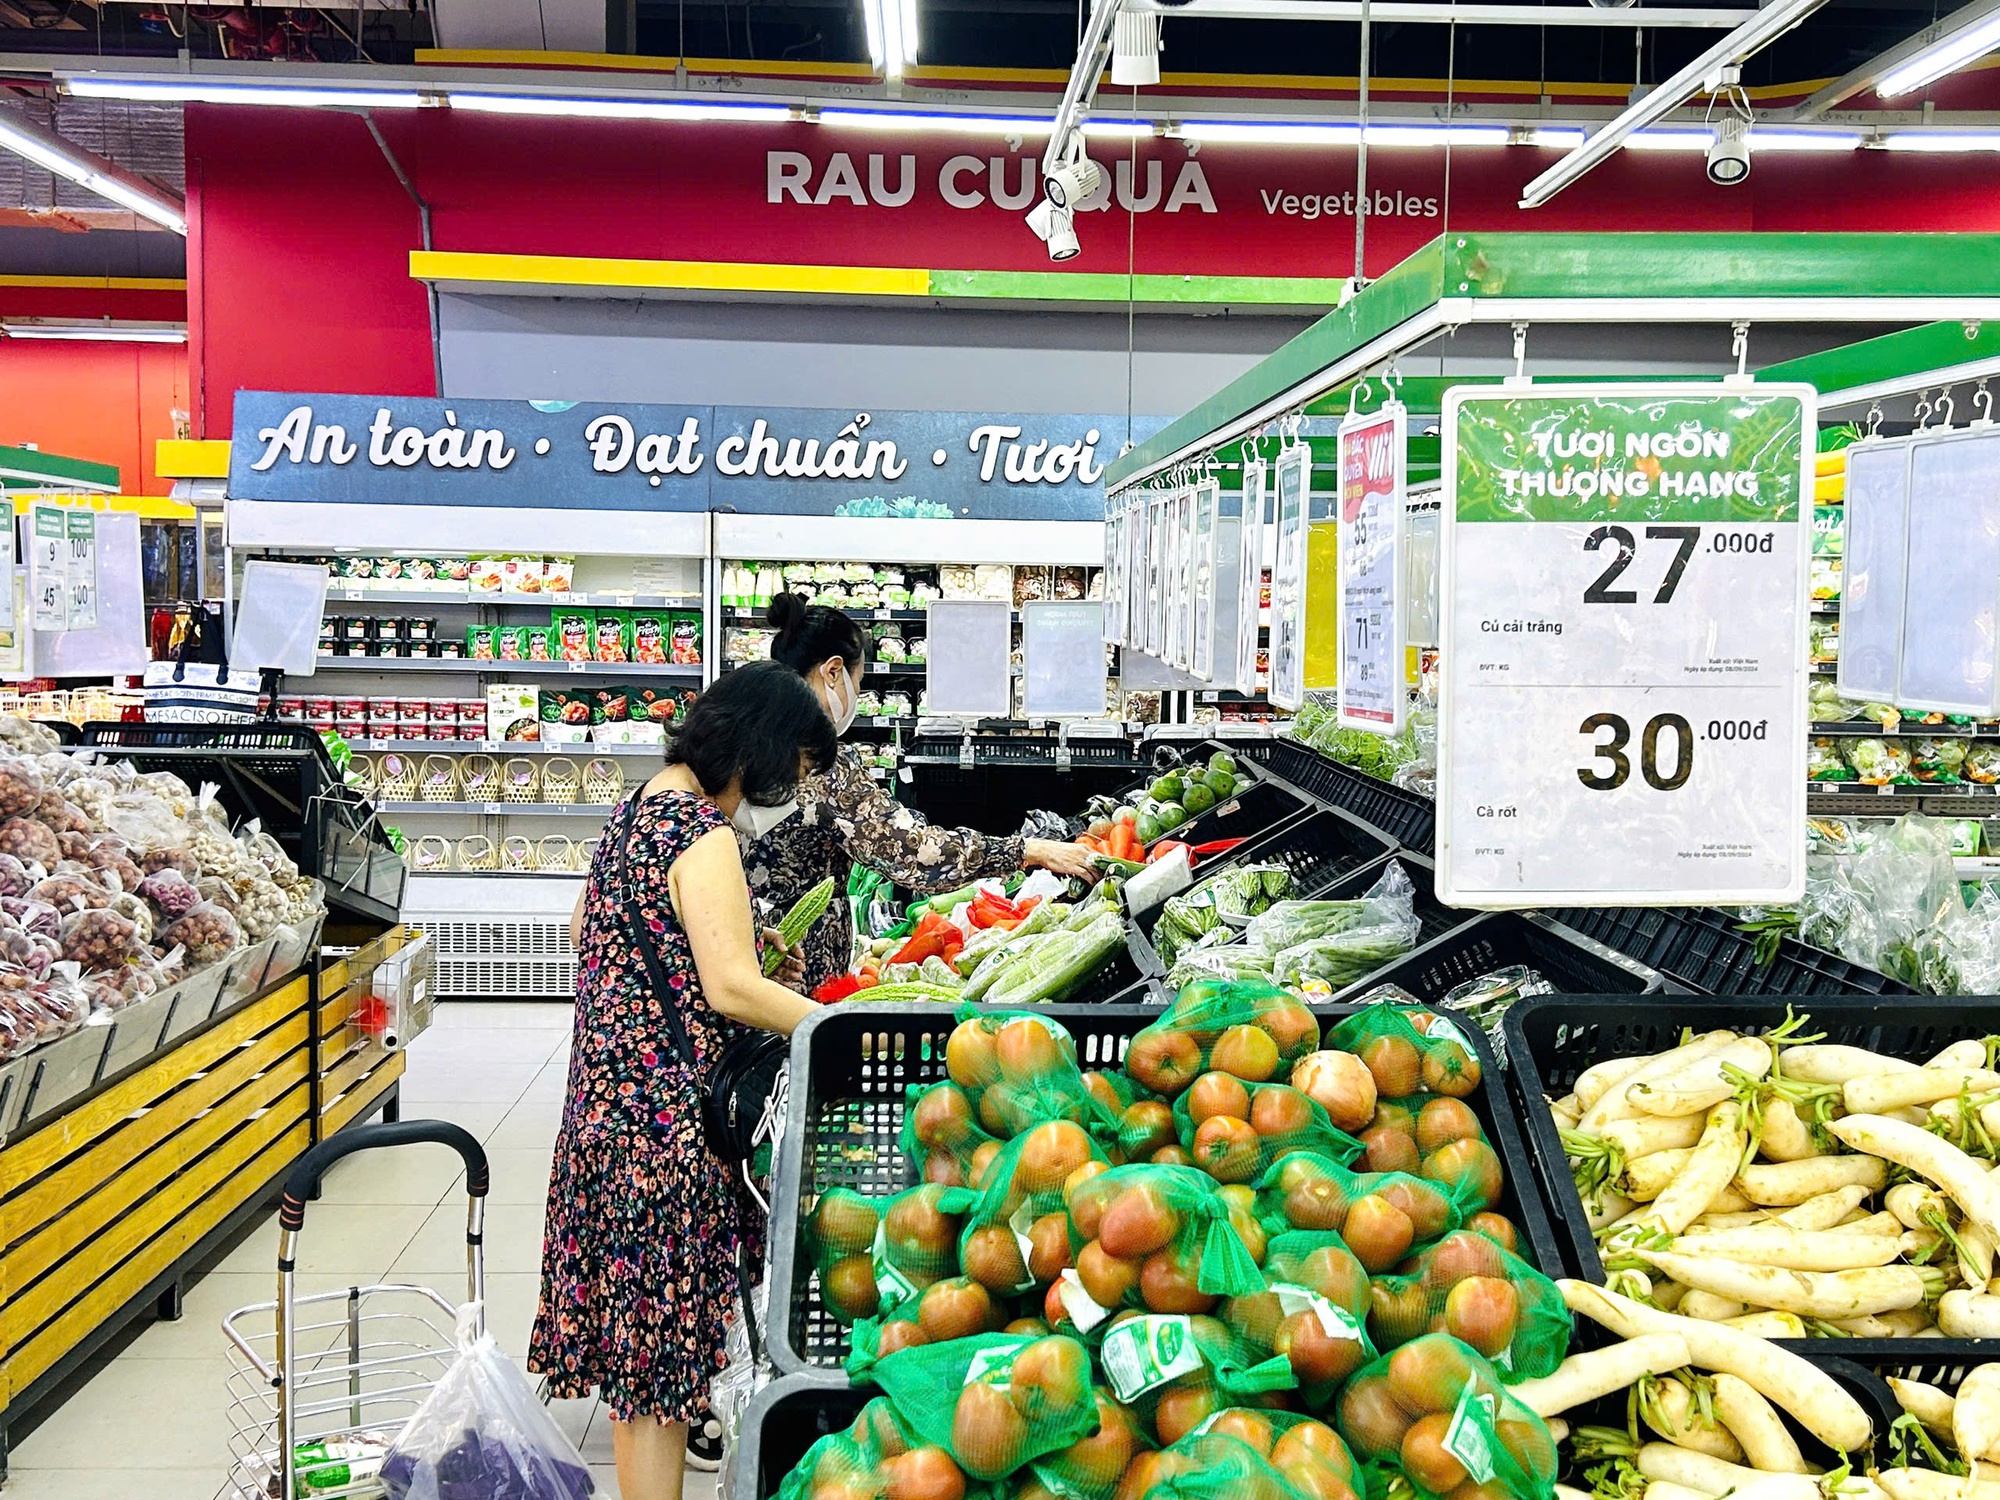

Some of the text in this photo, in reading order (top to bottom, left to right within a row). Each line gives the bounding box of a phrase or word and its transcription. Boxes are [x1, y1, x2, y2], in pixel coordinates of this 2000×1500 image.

[767, 150, 916, 208] RAU
[939, 133, 1037, 211] CỦ
[250, 405, 1104, 488] An toàn Đạt chuẩn Tươi
[1532, 427, 1616, 458] TƯƠI
[1500, 467, 1759, 504] THƯỢNG HẠNG
[71, 538, 88, 558] 100
[1583, 525, 1775, 604] 27 .000đ
[73, 585, 88, 605] 100
[1356, 617, 1368, 650] 71
[1481, 619, 1563, 635] Củ cải trắng
[1576, 712, 1769, 791] 30 .000đ
[1476, 804, 1518, 818] Cà rốt
